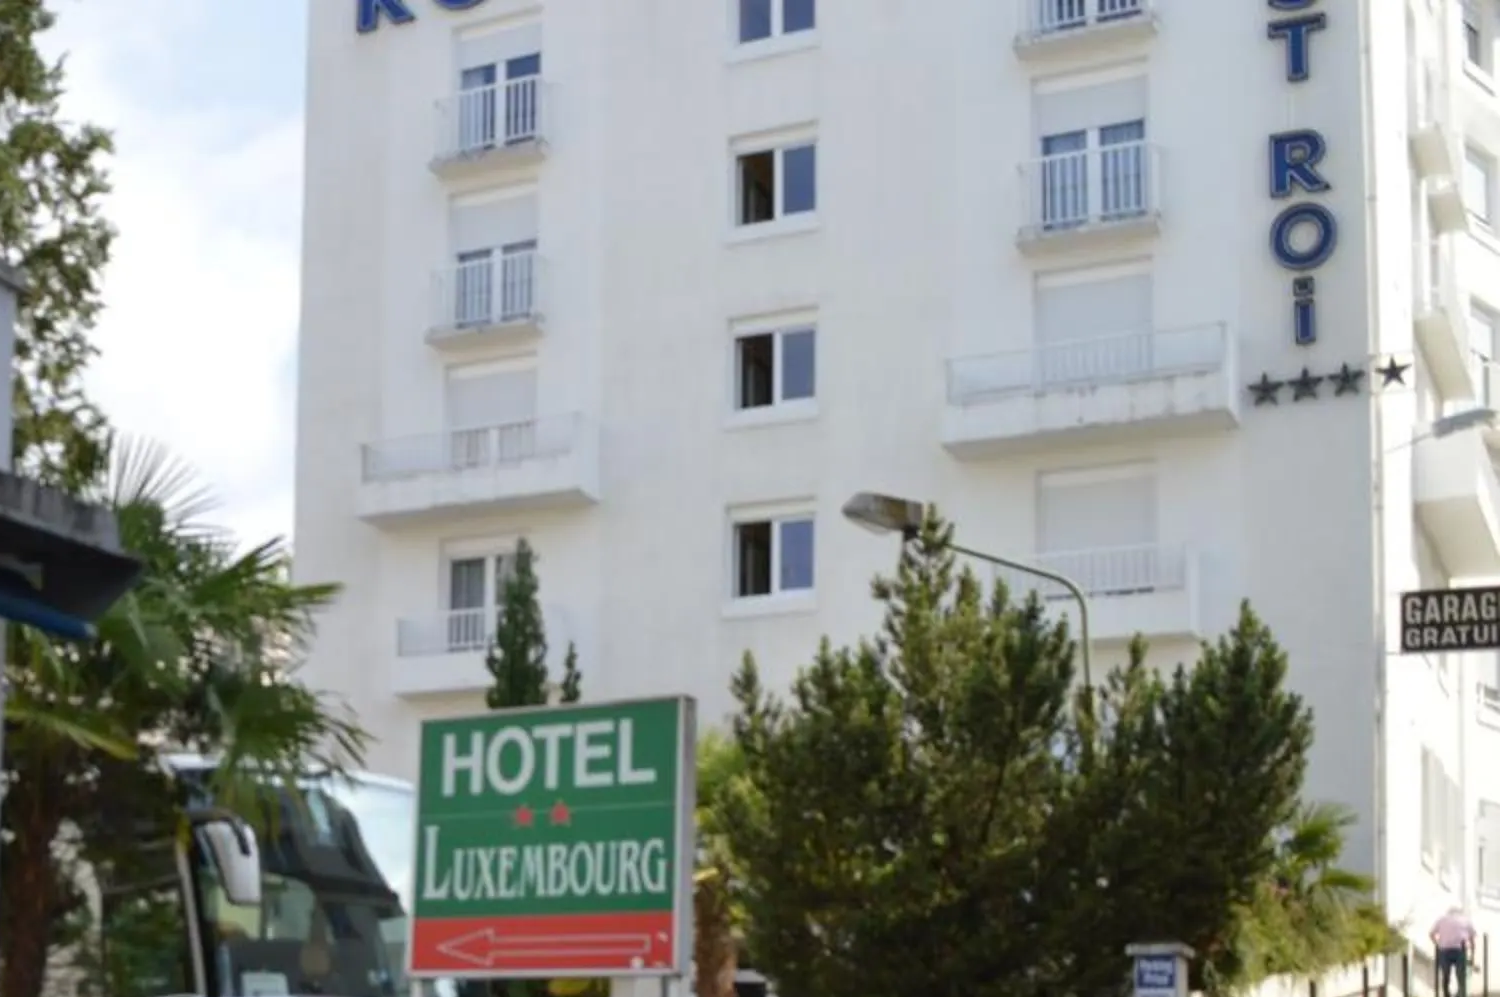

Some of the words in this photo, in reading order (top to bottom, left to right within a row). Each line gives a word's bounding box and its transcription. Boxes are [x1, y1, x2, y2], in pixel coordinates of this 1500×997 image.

[1267, 0, 1327, 82] T
[1405, 592, 1500, 624] GARAG
[441, 717, 658, 797] HOTEL
[422, 825, 668, 900] LUXEMBOURG
